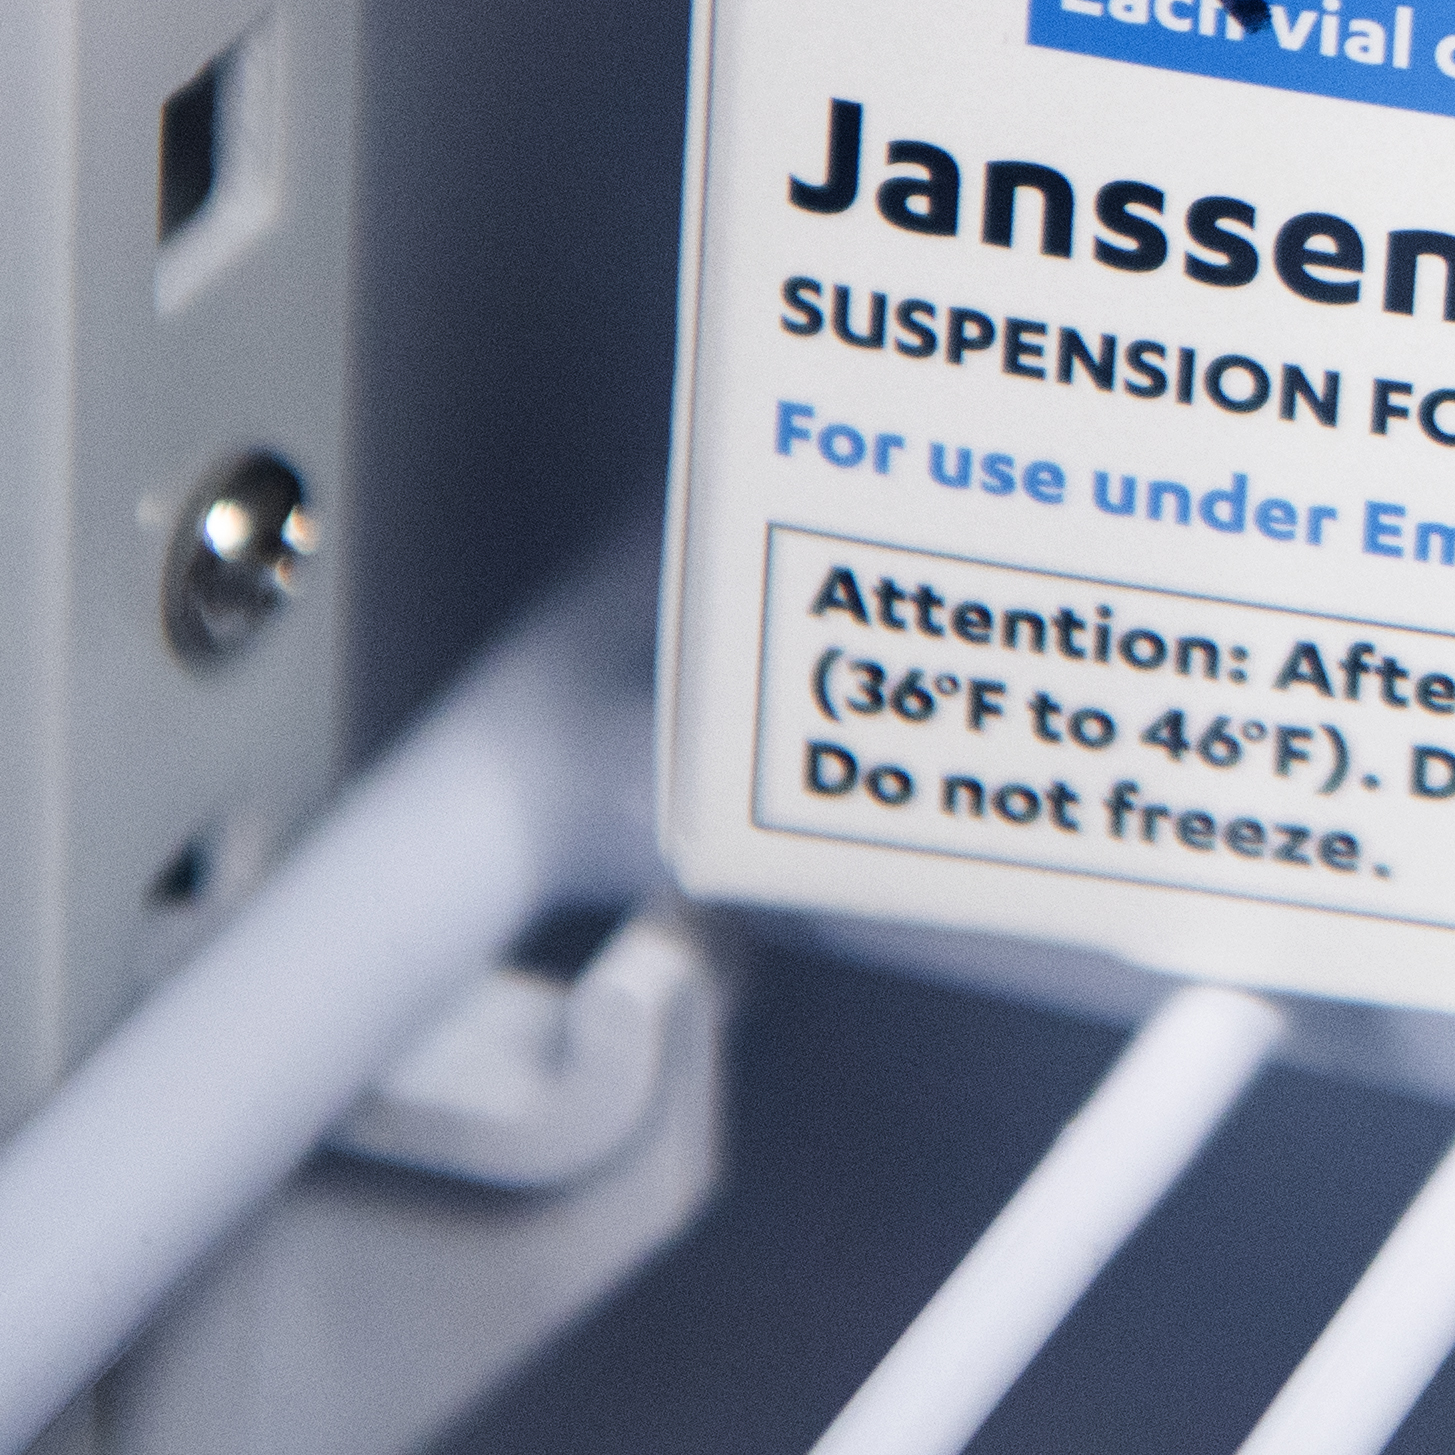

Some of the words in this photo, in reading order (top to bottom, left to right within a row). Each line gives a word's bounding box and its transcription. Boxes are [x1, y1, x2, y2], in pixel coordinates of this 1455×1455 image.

[778, 276, 1342, 428] SUSPENSION
[773, 400, 906, 479] For
[927, 440, 1067, 505] use
[1092, 466, 1340, 548] under
[808, 564, 1250, 685] Attention:
[808, 648, 1009, 735] (36°F
[1030, 691, 1117, 756] to
[1139, 707, 1382, 796] 46°F).
[801, 742, 916, 807] Do
[939, 773, 1082, 833] not
[1105, 780, 1394, 878] freeze.
